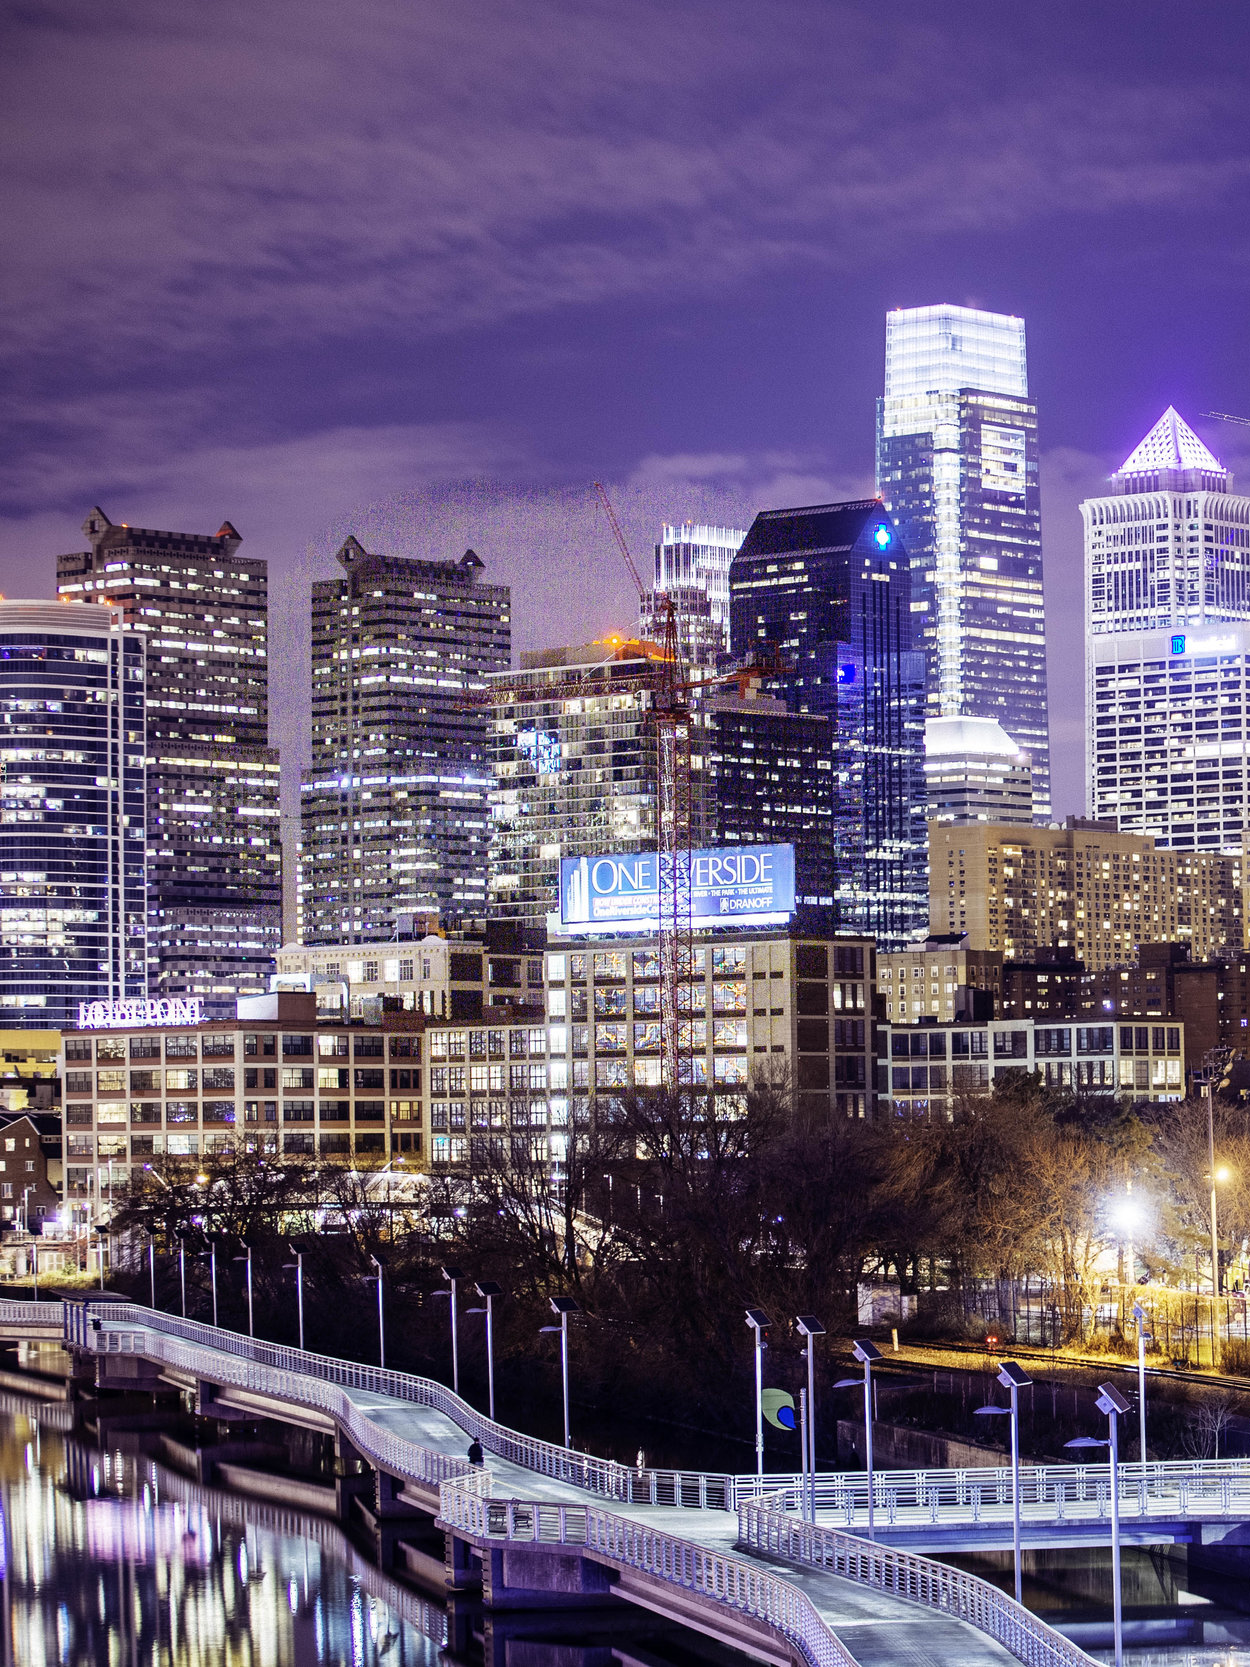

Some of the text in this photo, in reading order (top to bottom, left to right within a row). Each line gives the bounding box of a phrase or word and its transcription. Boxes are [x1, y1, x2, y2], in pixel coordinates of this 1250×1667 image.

[591, 859, 651, 894] ONE
[721, 888, 735, 896] PARK
[729, 896, 774, 910] DRANOFF
